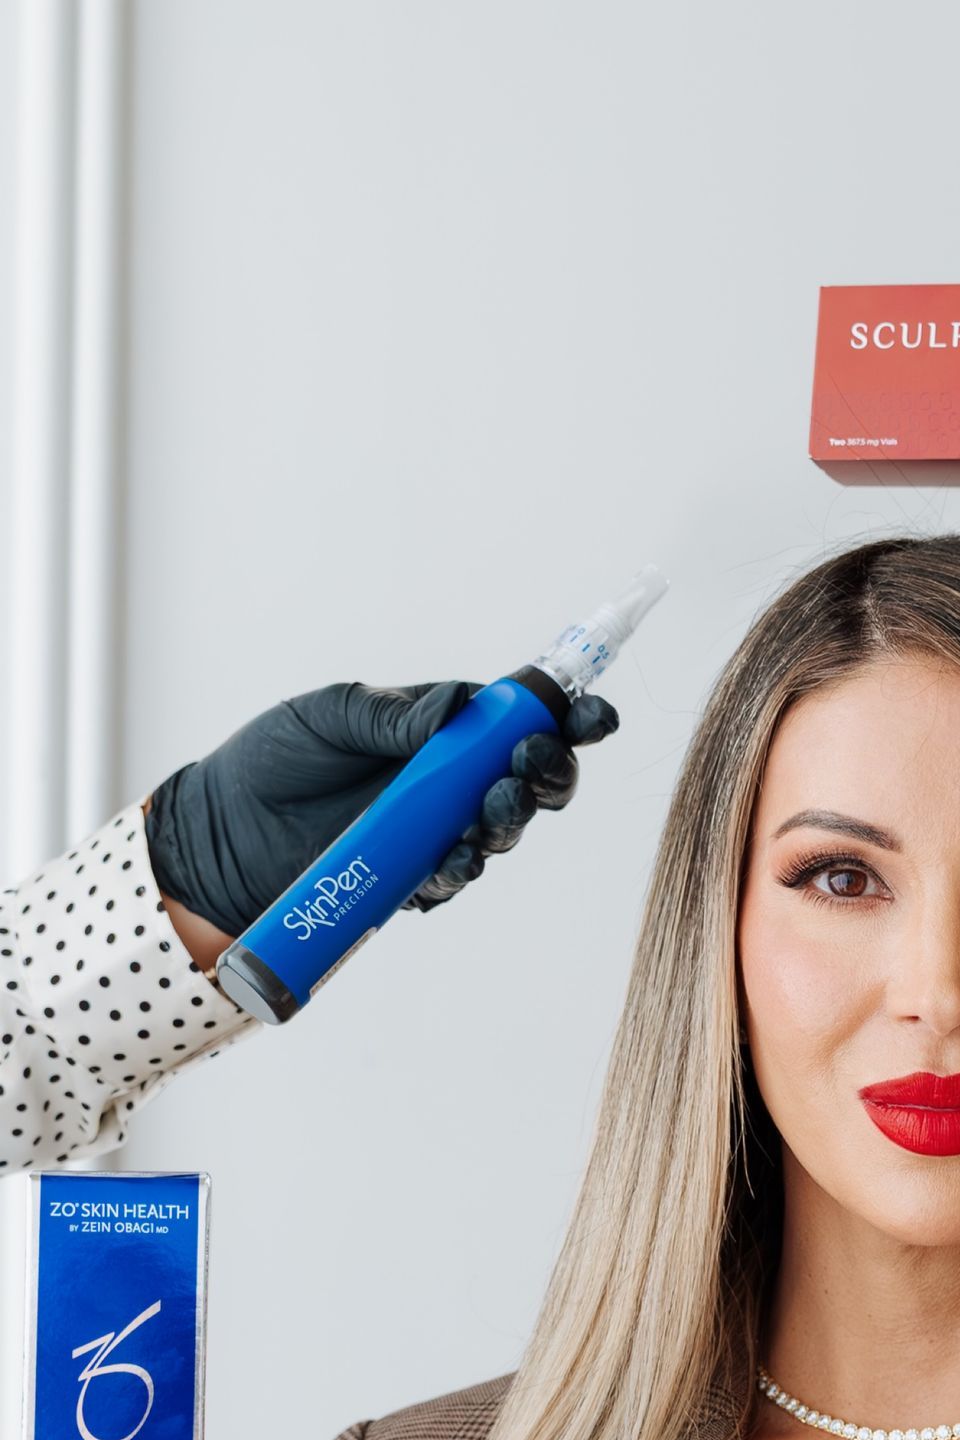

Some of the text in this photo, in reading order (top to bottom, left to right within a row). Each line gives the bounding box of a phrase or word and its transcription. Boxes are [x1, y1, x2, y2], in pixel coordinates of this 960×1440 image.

[333, 873, 379, 921] PRECISION
[81, 1203, 119, 1218] SKIN
[123, 1204, 189, 1219] HEALTH
[69, 1221, 169, 1234] BY ZEIN OBAGI MD
